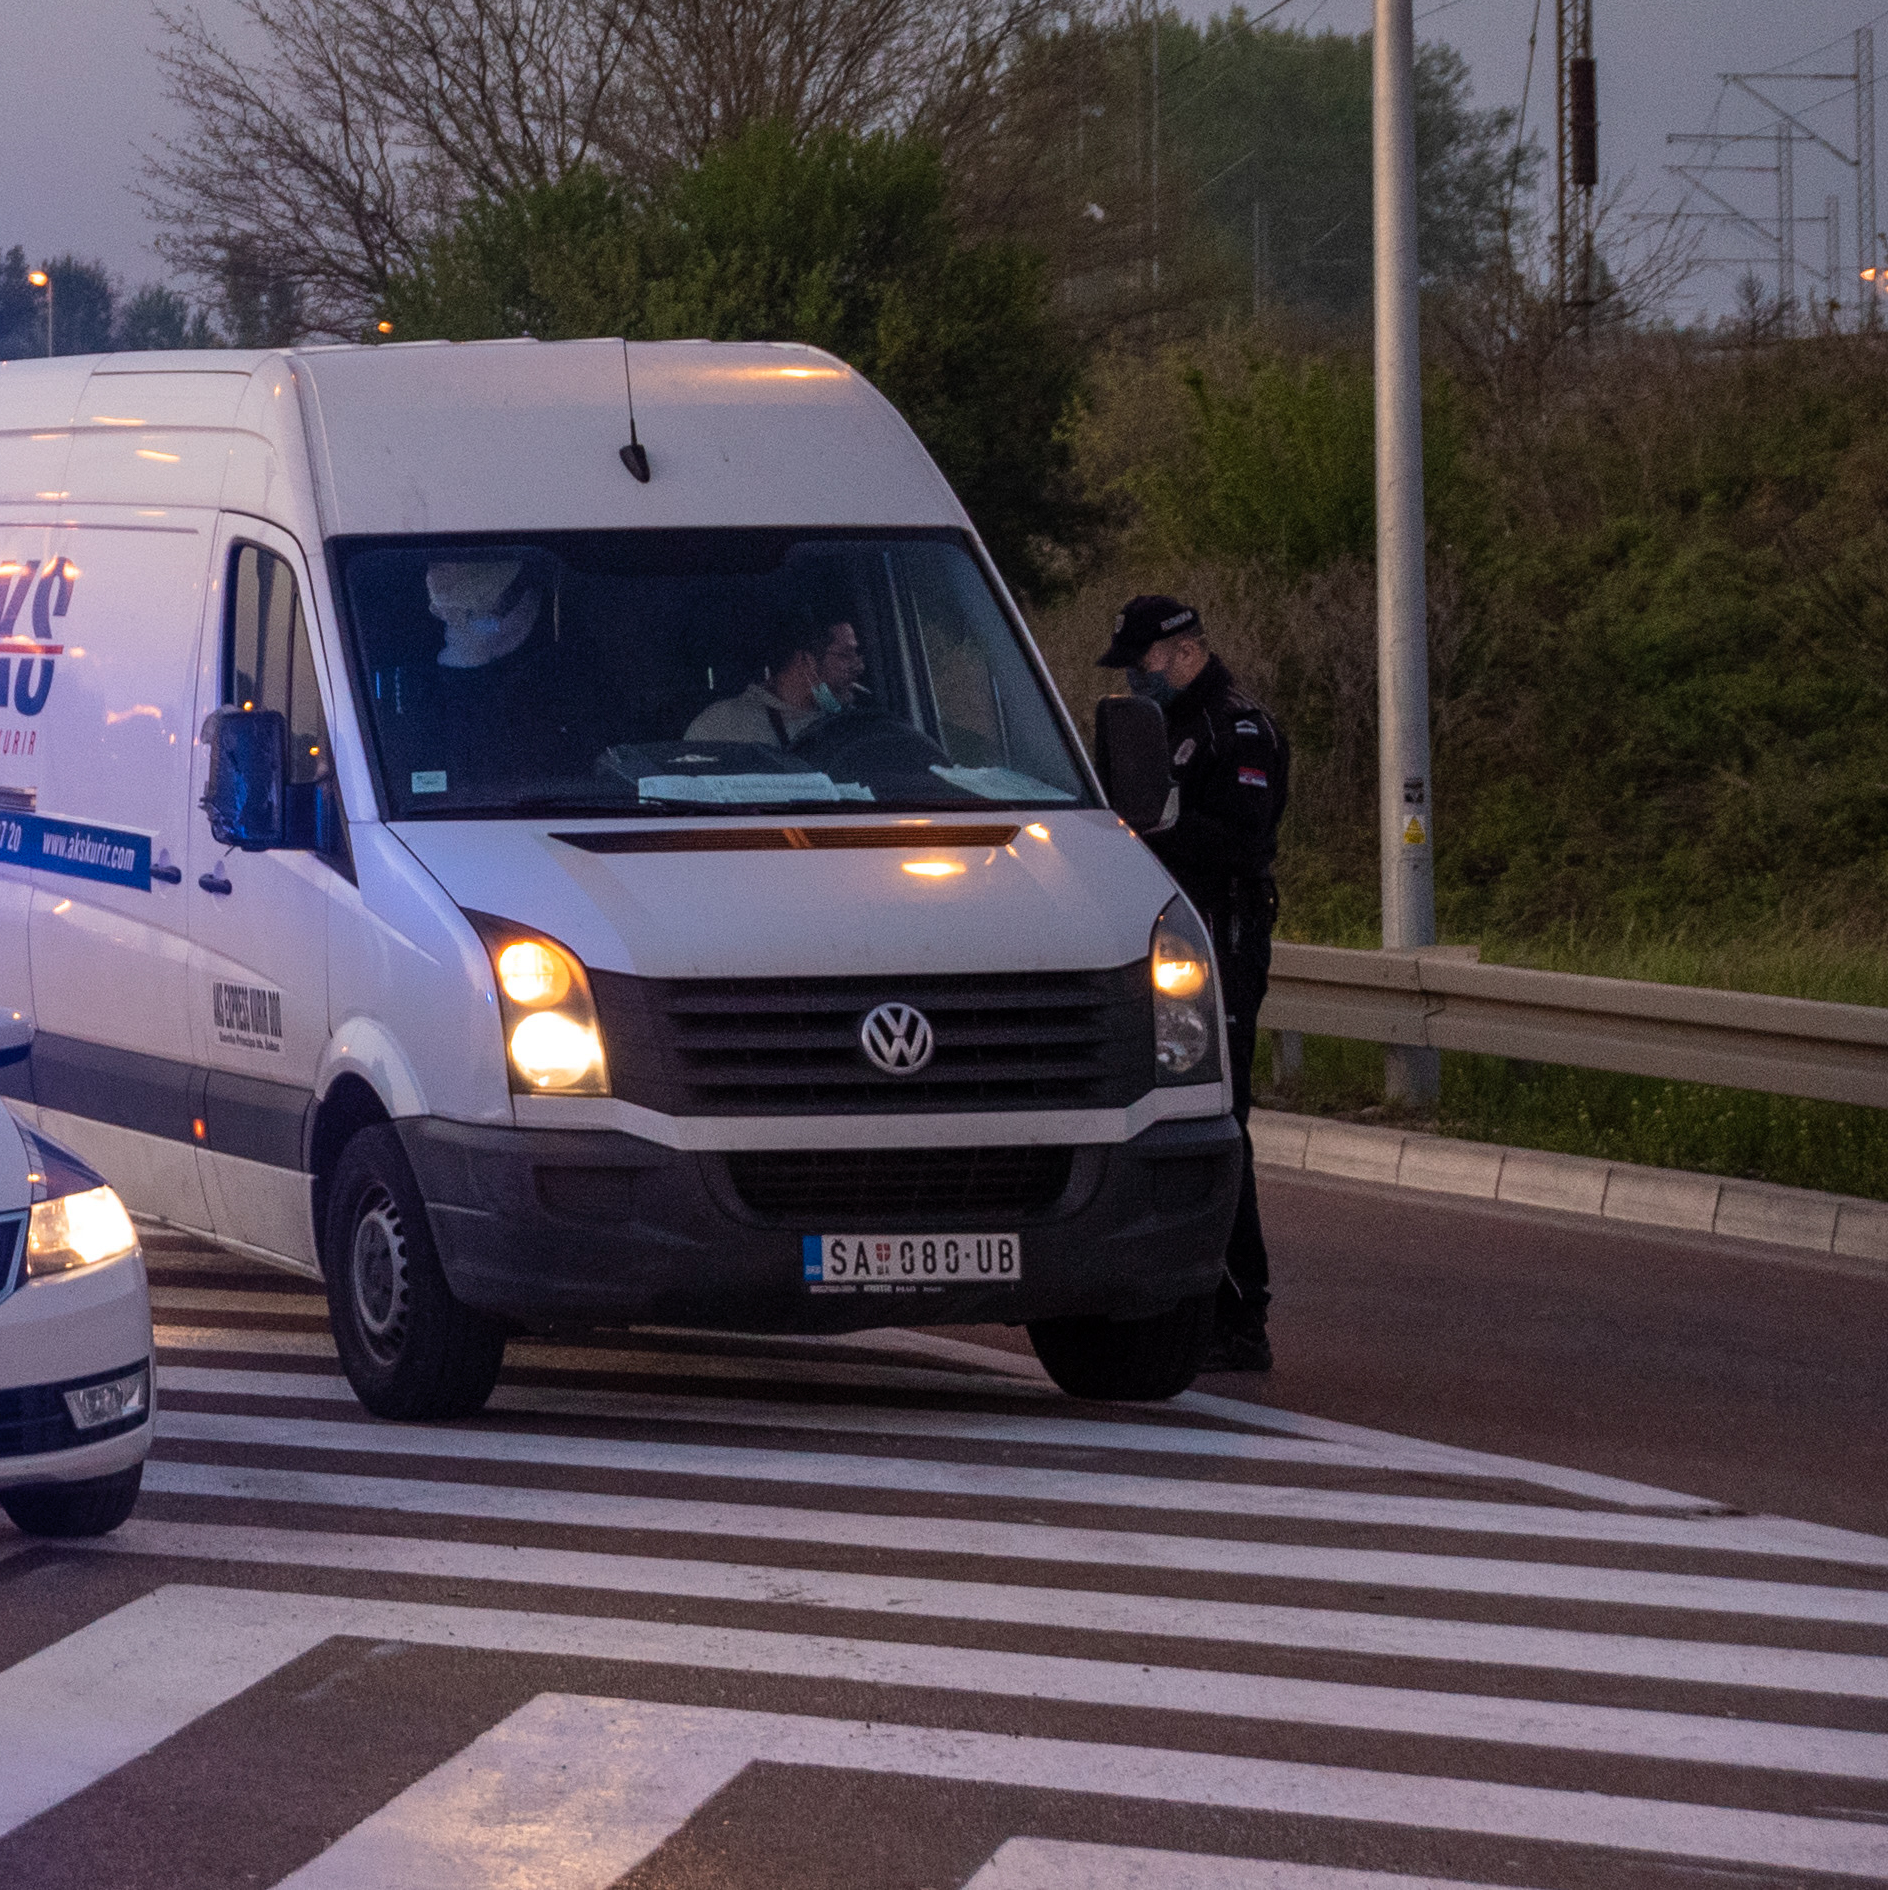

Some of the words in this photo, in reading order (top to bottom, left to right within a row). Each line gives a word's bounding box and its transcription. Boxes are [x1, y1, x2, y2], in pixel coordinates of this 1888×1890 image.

[7, 822, 22, 853] 20
[42, 831, 136, 872] www.akskurir.com
[830, 1238, 872, 1276] ŠA
